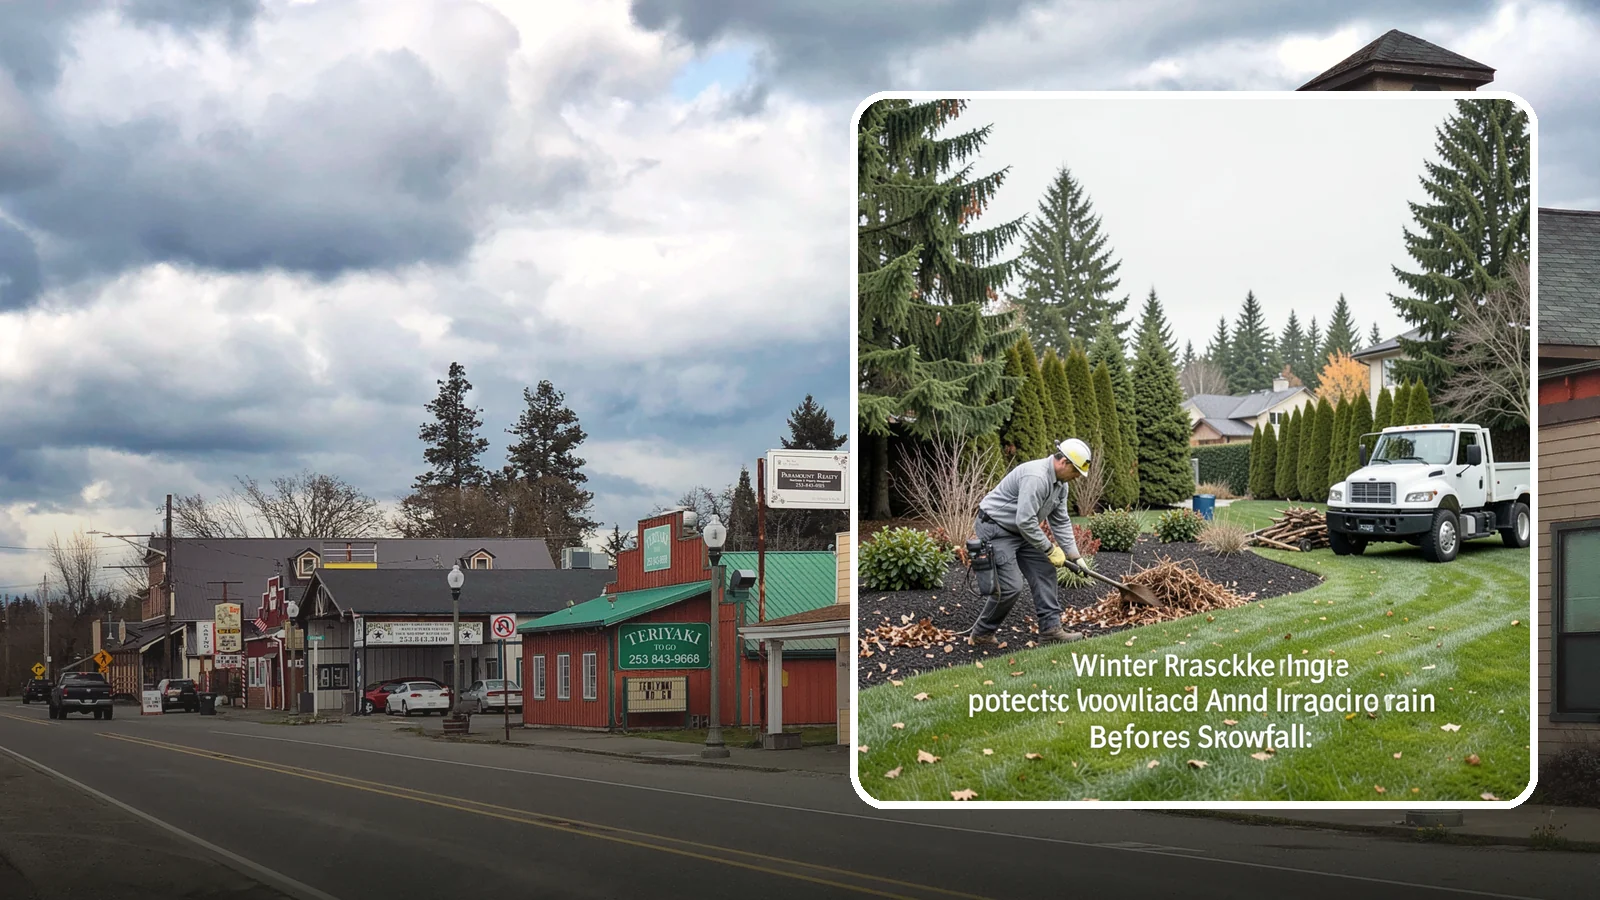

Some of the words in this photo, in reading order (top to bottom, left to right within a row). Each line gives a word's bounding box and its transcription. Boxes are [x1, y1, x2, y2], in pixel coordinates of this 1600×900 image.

[781, 471, 815, 479] PARAMOUNT
[624, 627, 702, 646] TERIYAKI
[654, 643, 664, 651] TO
[665, 643, 677, 651] GO
[629, 654, 649, 665] 253
[651, 653, 700, 664] 843-9668
